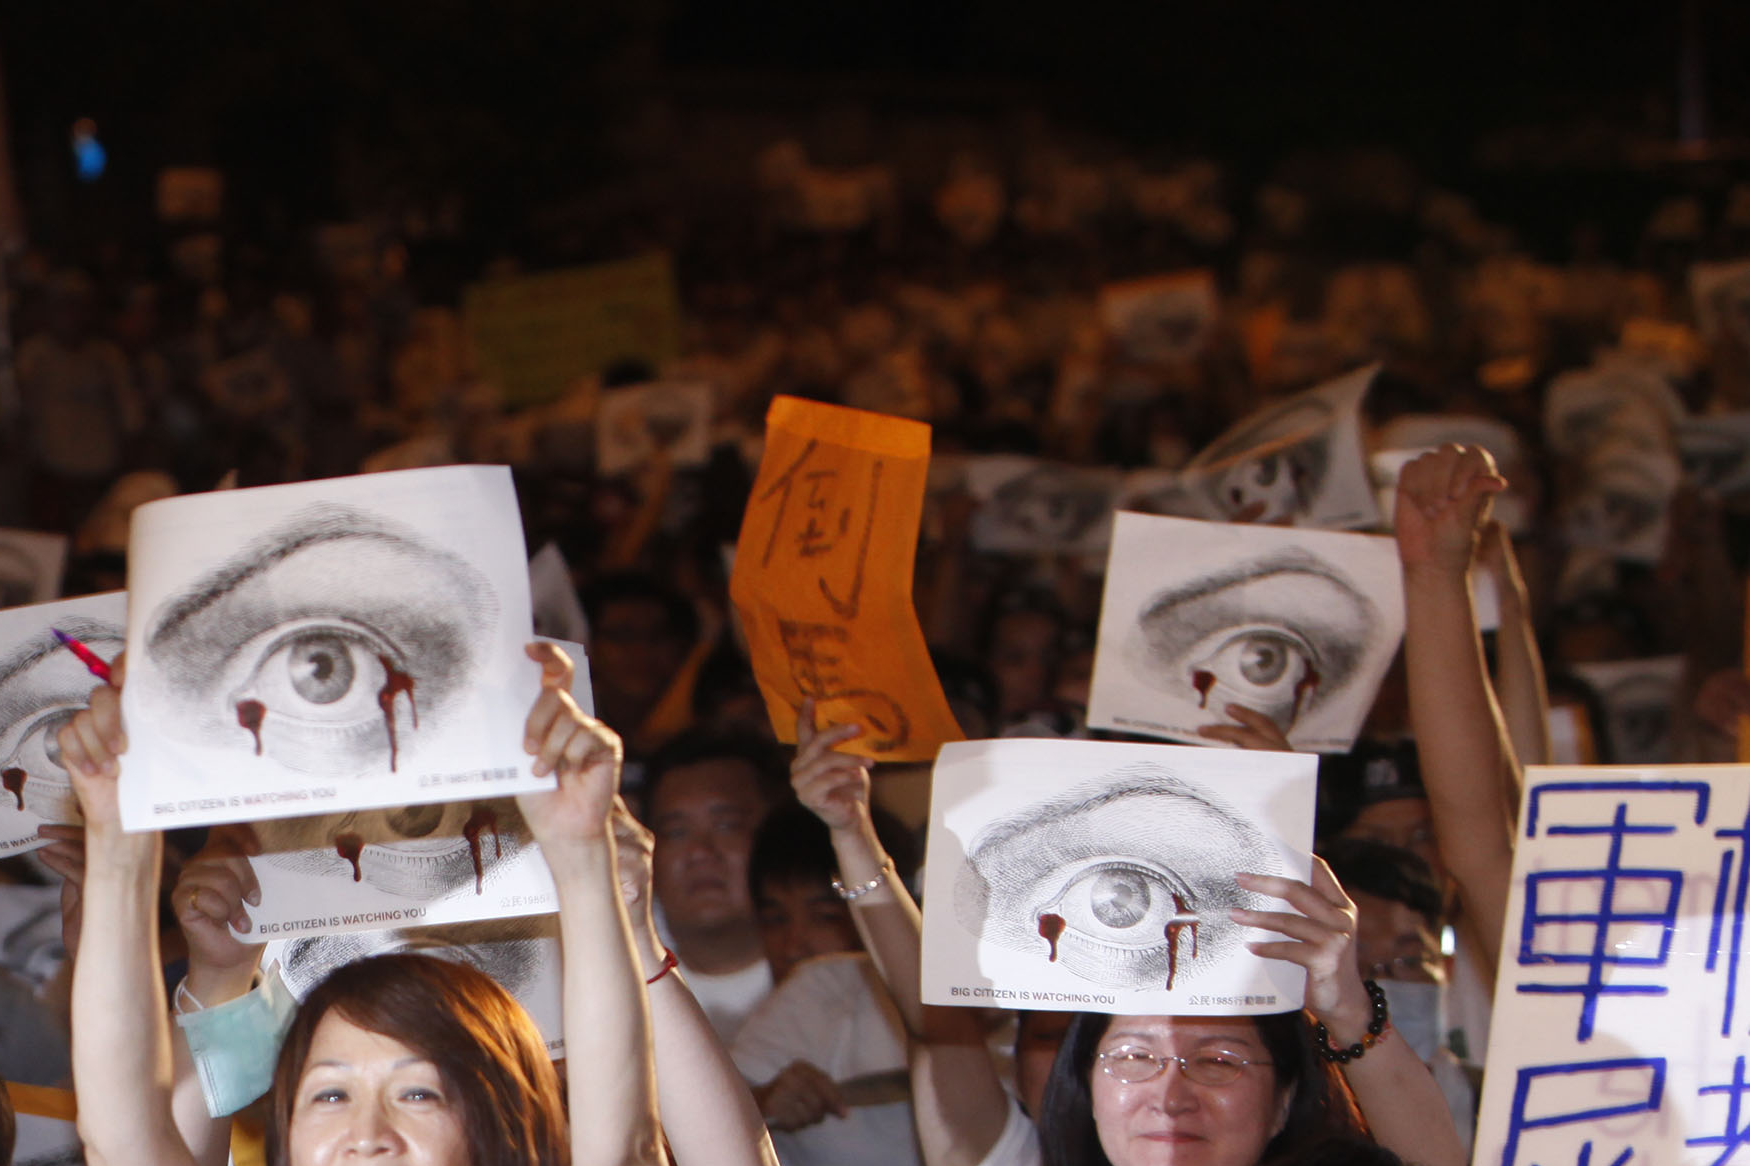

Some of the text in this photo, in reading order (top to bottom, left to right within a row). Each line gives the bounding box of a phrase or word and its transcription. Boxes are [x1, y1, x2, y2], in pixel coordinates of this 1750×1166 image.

[154, 786, 336, 815] BIG CITIZEN IS WATCHING YOU
[0, 841, 9, 850] IS
[11, 834, 37, 849] WATC
[500, 894, 551, 908] 公民1985
[260, 907, 427, 935] BIG CITIZEN IS WATCHING YOU
[951, 987, 1116, 1006] BIG CITIZEN IS WATCHING YOU
[1189, 995, 1277, 1006] 公民1985行動聯盟
